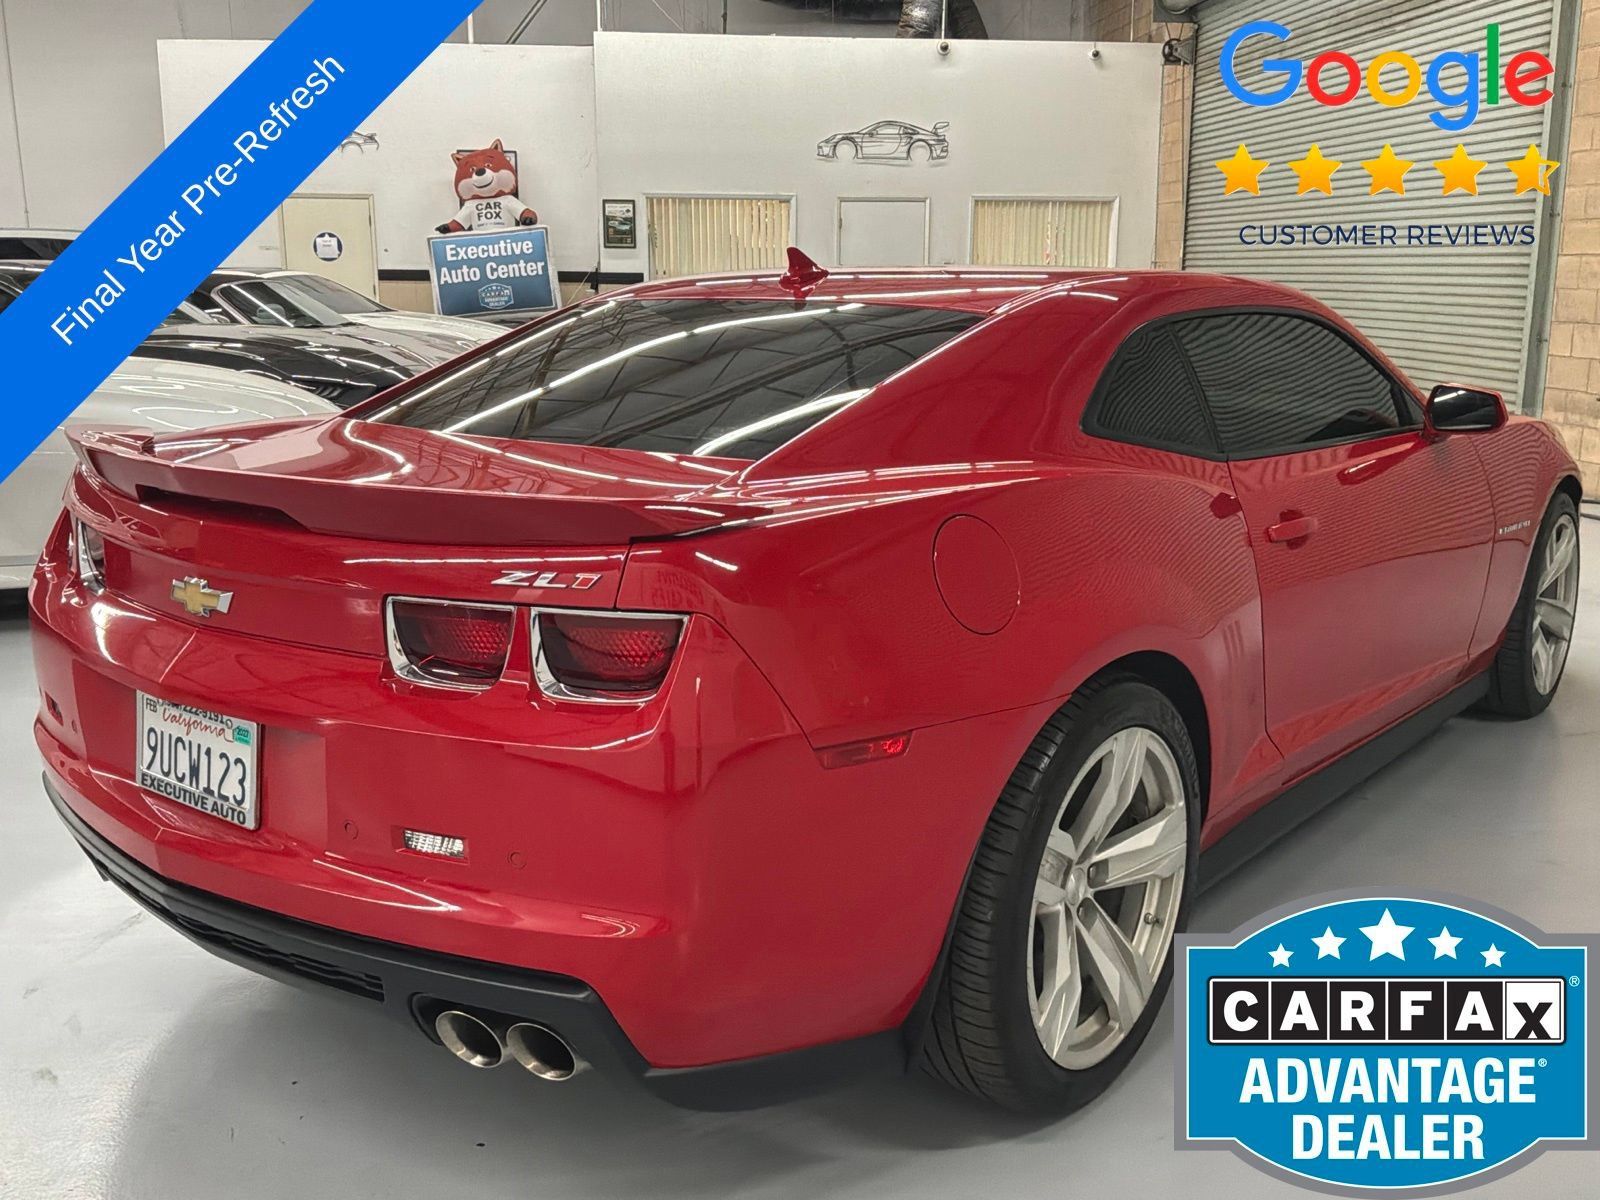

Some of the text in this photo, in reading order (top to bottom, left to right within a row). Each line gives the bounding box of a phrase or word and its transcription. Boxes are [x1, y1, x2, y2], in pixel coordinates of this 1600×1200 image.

[475, 201, 503, 212] CAR
[476, 210, 503, 221] FOX
[445, 239, 534, 261] Executive
[440, 260, 545, 285] Auto Center
[491, 570, 603, 590] ZL1
[145, 697, 158, 713] FEB
[162, 707, 227, 738] California
[147, 727, 247, 806] 9UCW123
[141, 772, 247, 825] EXECUTIVE AUTO
